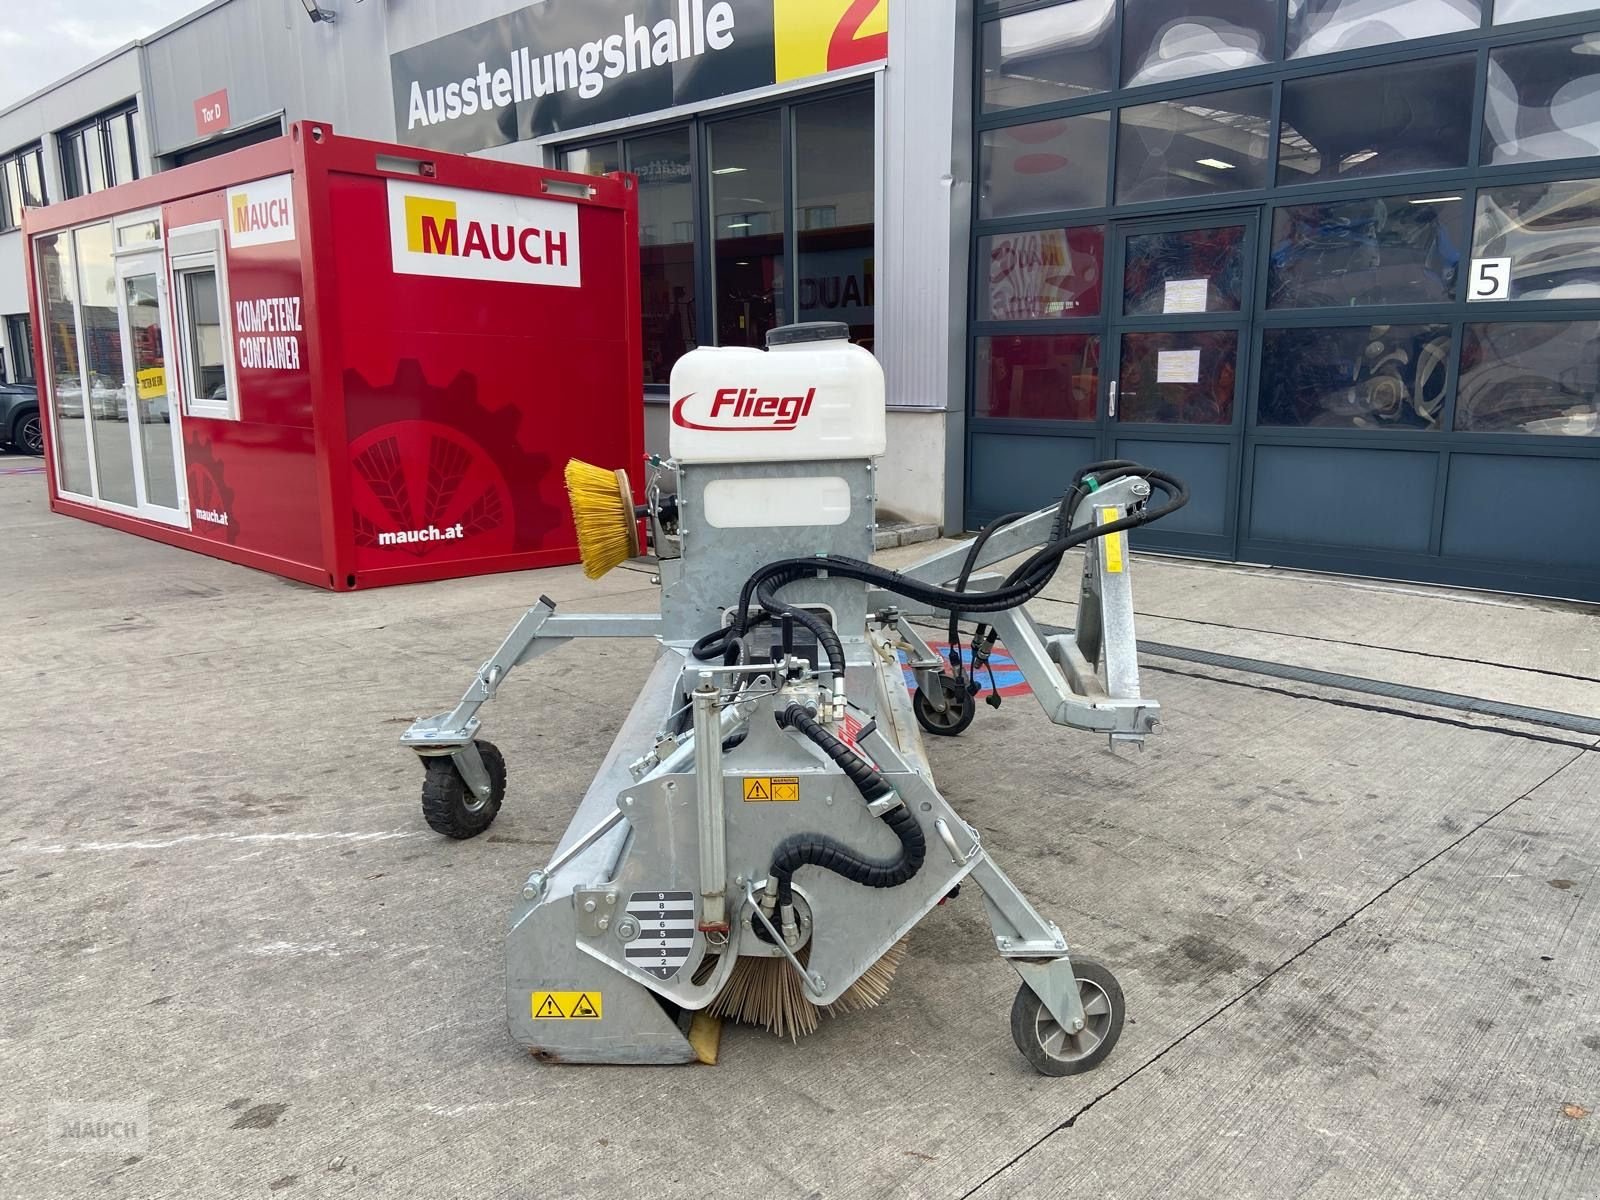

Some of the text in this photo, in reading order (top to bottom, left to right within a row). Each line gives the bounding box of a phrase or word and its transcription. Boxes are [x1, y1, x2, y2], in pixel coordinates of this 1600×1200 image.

[407, 0, 735, 130] Ausstellungshalle
[201, 103, 221, 124] Tor D
[238, 198, 289, 233] MAUCH
[421, 215, 568, 266] MAUCH
[1476, 263, 1499, 296] 5
[236, 297, 302, 333] KOMPETENZ
[239, 336, 300, 370] CONTAINER
[709, 387, 816, 425] Fliegl
[195, 508, 229, 526] mauch.at
[378, 523, 464, 545] mauch.at
[661, 967, 667, 975] 1
